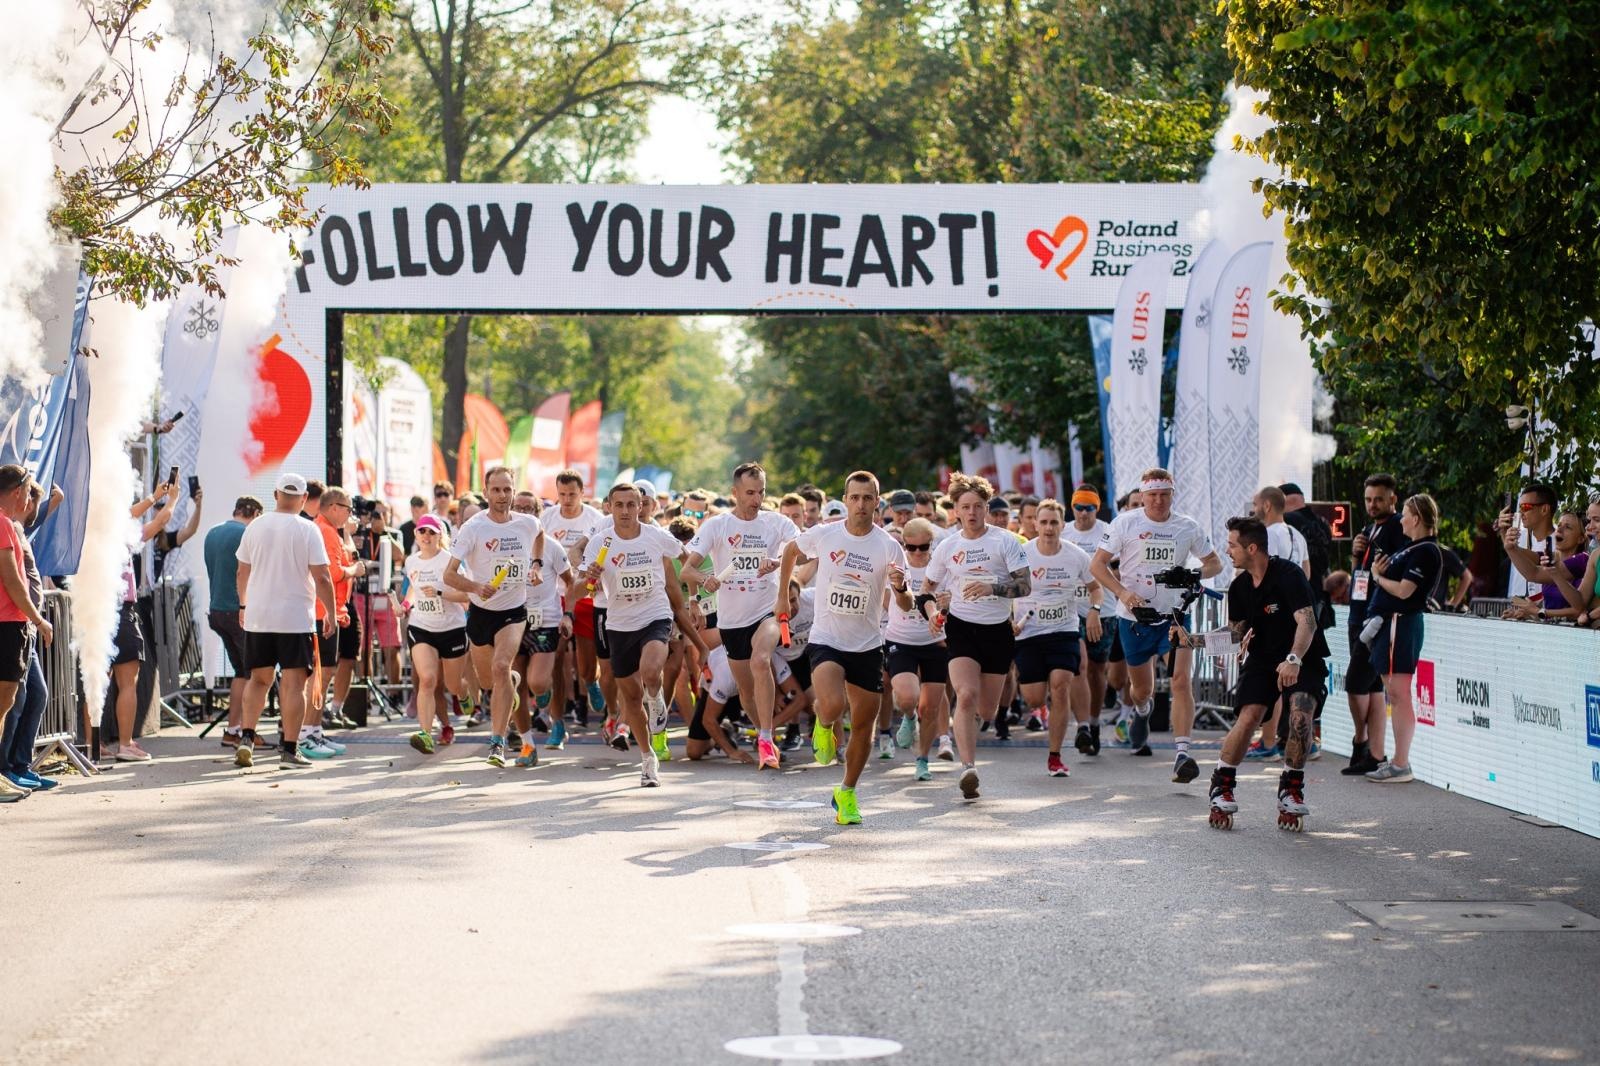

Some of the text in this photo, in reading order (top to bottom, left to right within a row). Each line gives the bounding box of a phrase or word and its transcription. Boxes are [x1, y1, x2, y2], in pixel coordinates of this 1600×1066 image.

[1097, 220, 1178, 237] Poland
[566, 201, 736, 283] YOUR
[765, 210, 999, 298] HEART!
[1131, 291, 1151, 342] UBS
[1231, 286, 1251, 339] UBS
[1145, 547, 1169, 560] 1130
[622, 575, 647, 589] 0333
[830, 592, 861, 610] 0140
[1038, 606, 1063, 620] 0630
[1456, 677, 1479, 707] FOCUS
[1479, 681, 1490, 709] ON
